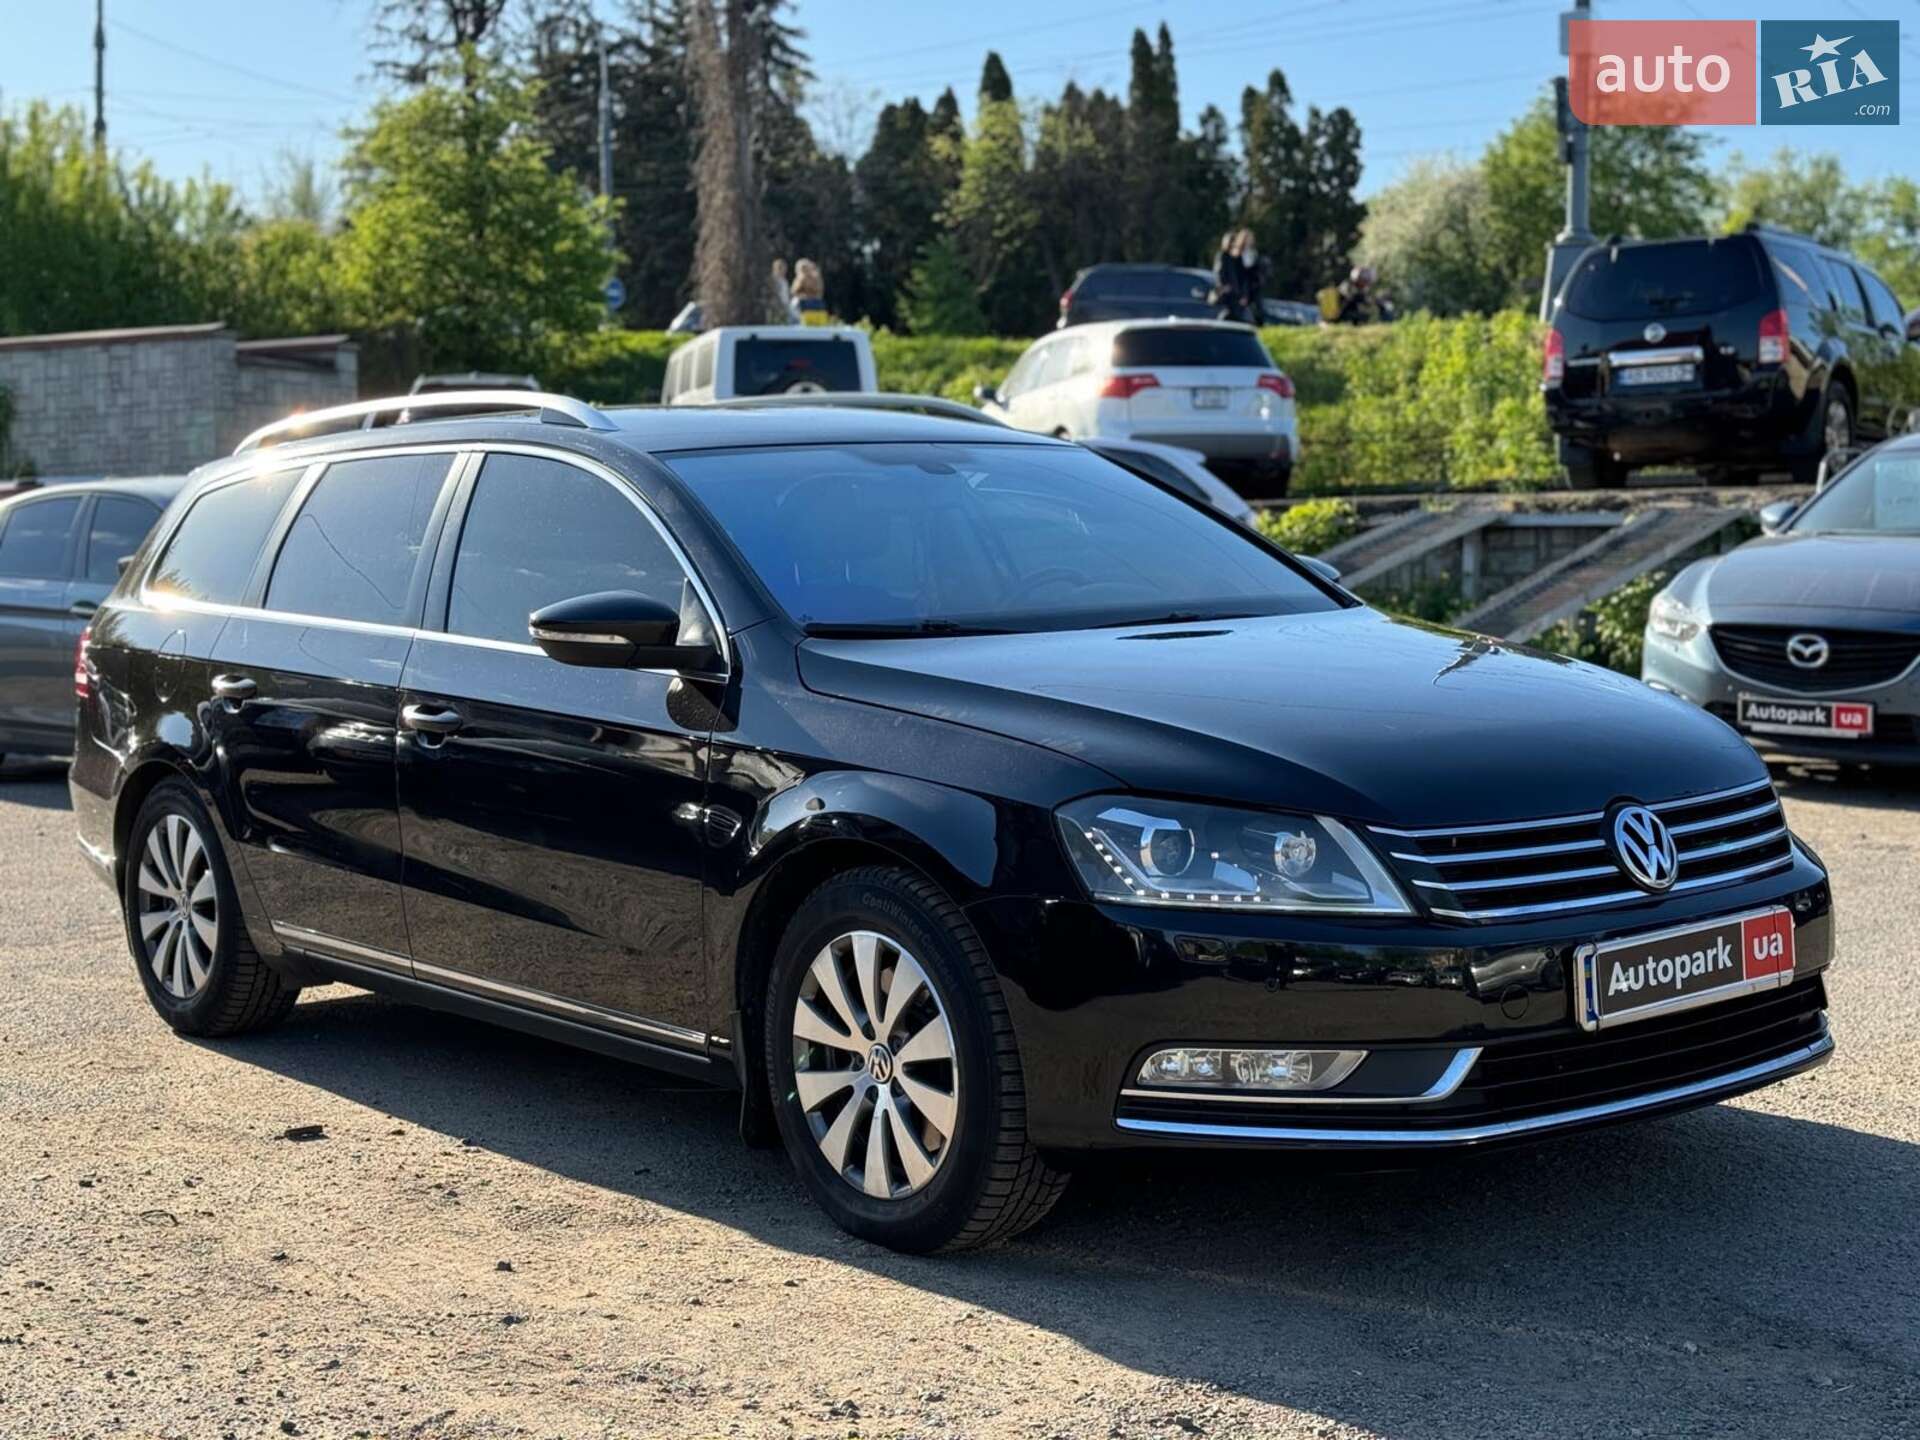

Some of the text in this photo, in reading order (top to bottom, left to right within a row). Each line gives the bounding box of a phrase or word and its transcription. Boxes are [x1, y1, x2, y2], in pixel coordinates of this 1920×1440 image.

[1747, 704, 1862, 725] Autopark ua
[1608, 932, 1783, 996] Autopark ua
